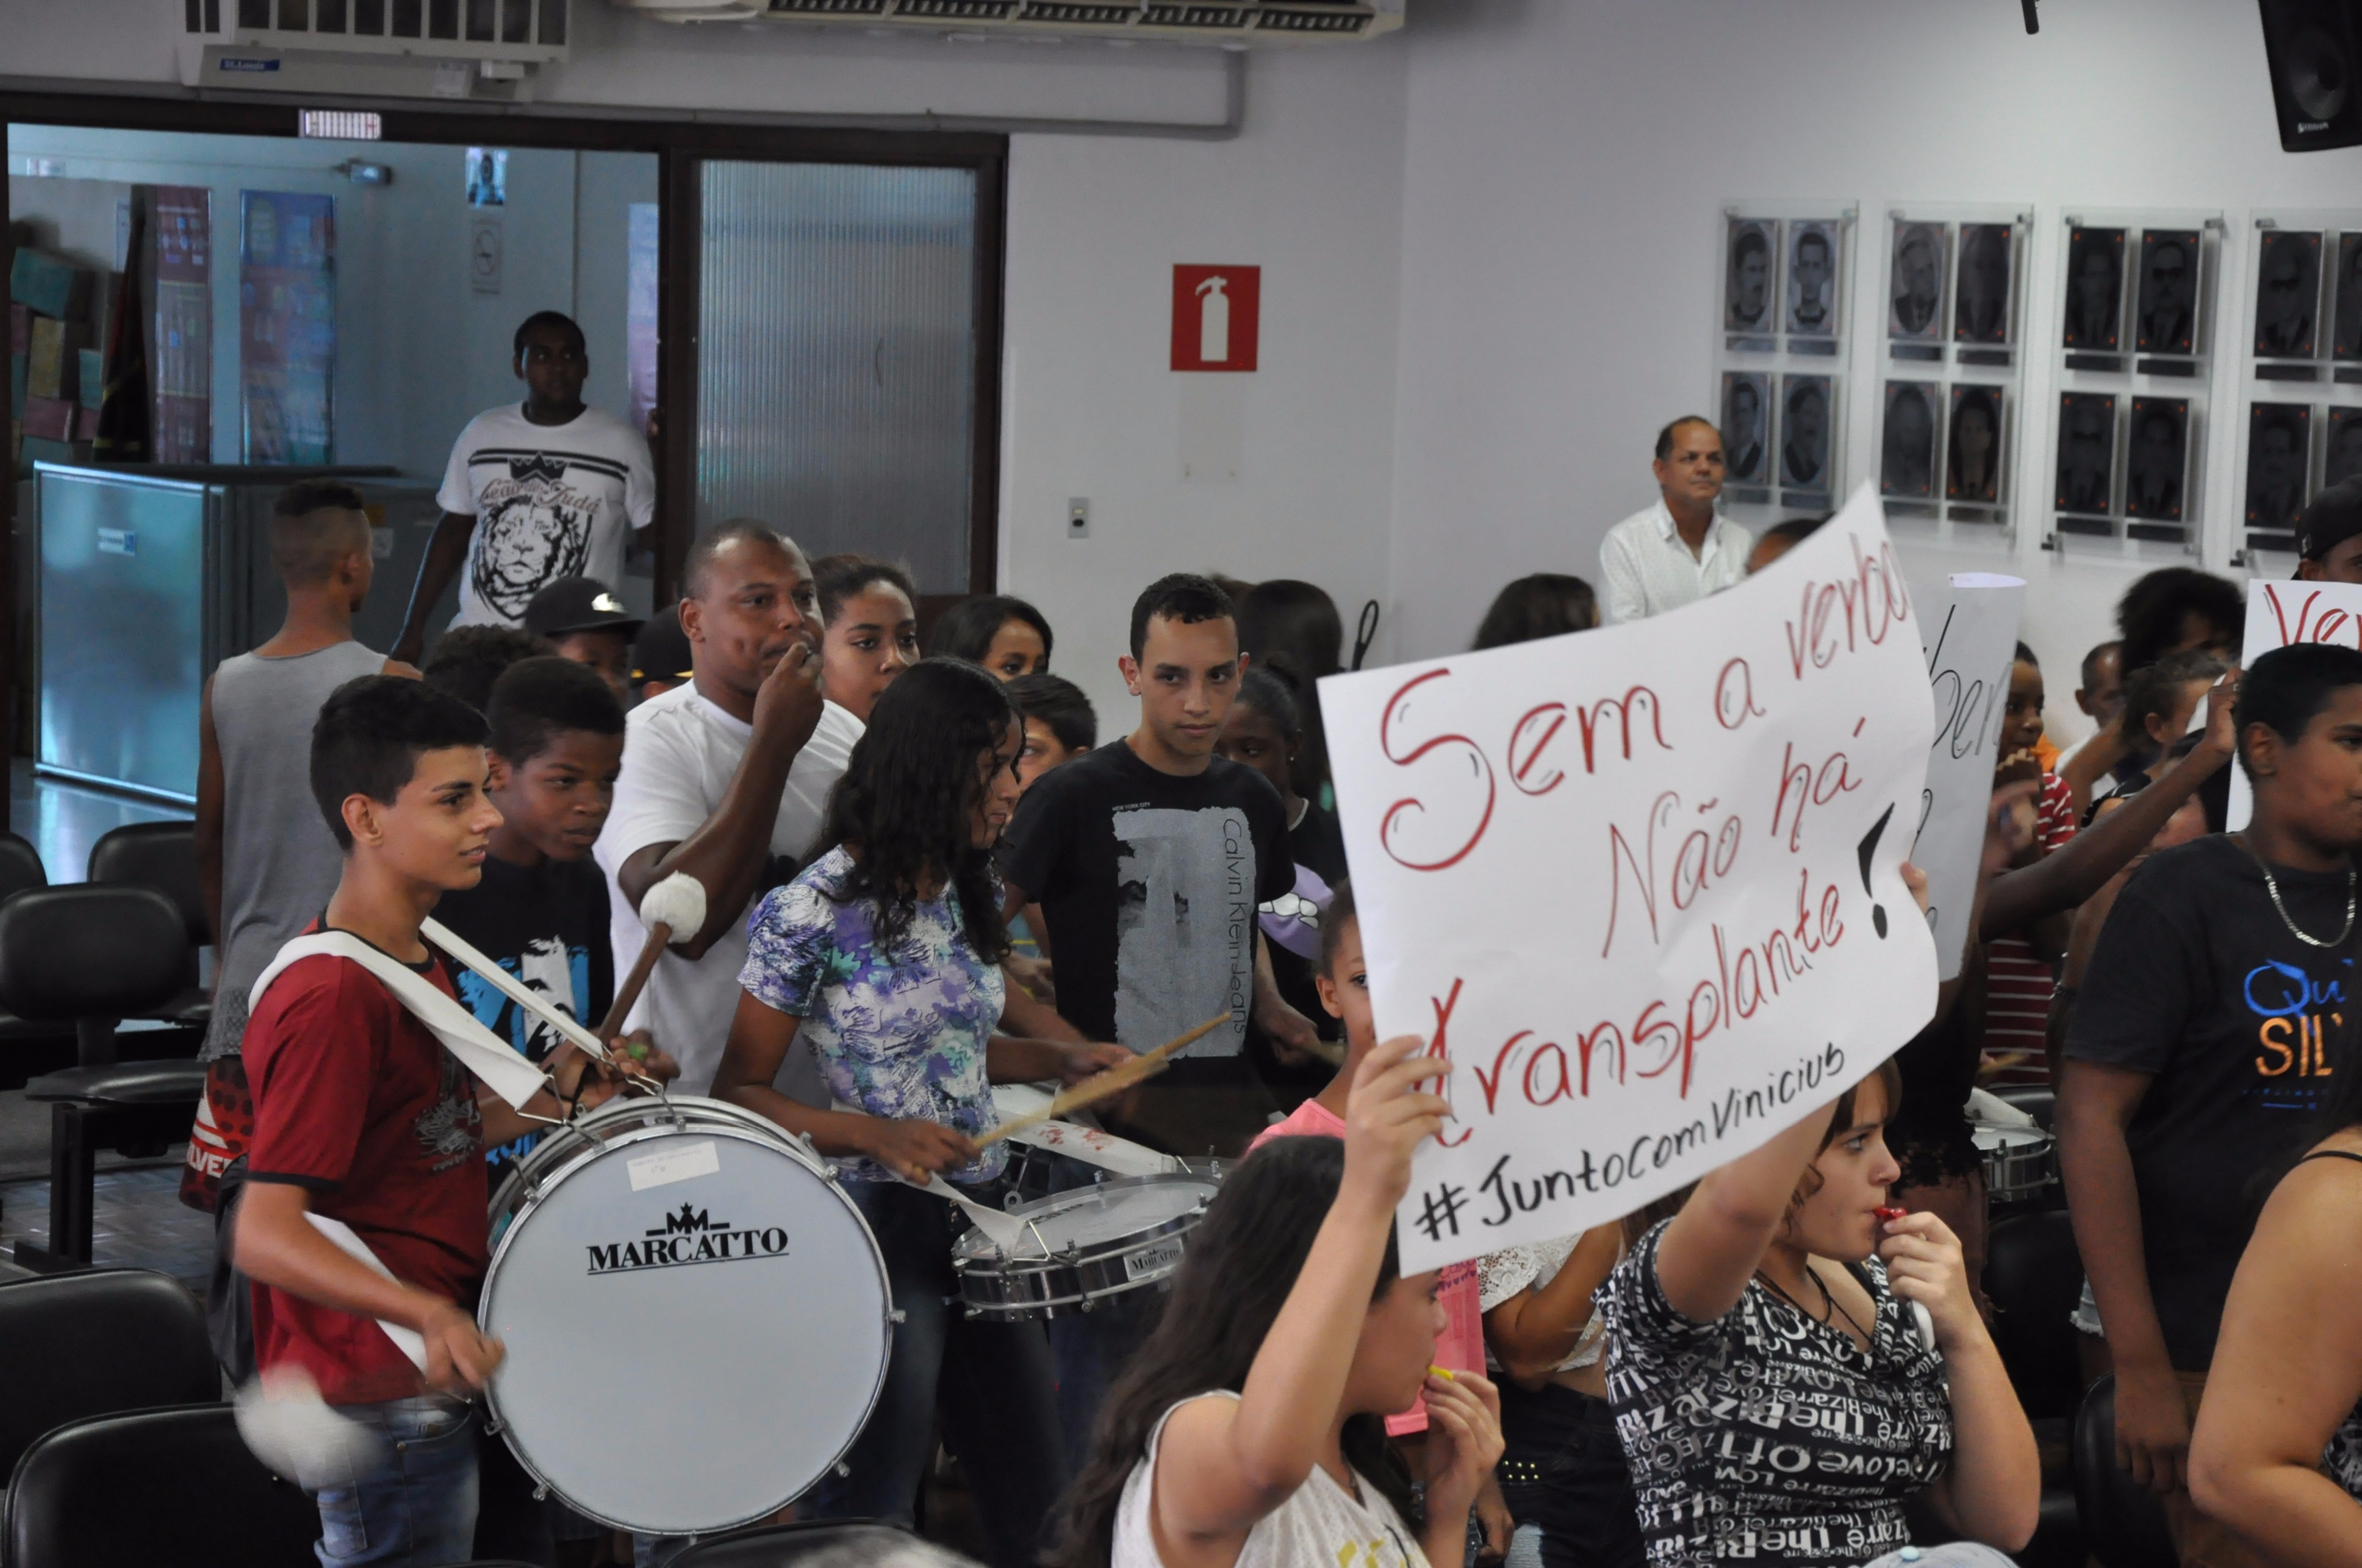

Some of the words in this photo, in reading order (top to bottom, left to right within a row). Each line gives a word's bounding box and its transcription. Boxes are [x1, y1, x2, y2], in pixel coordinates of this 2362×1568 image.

[2263, 584, 2362, 654] Ve
[1380, 667, 1673, 872] Sem
[1714, 656, 1767, 730] a
[1222, 818, 1248, 895] Calvin
[1603, 790, 1743, 958] Não
[1772, 717, 1868, 852] há
[2255, 1012, 2344, 1078] SIL
[586, 1226, 789, 1272] MARCATTO
